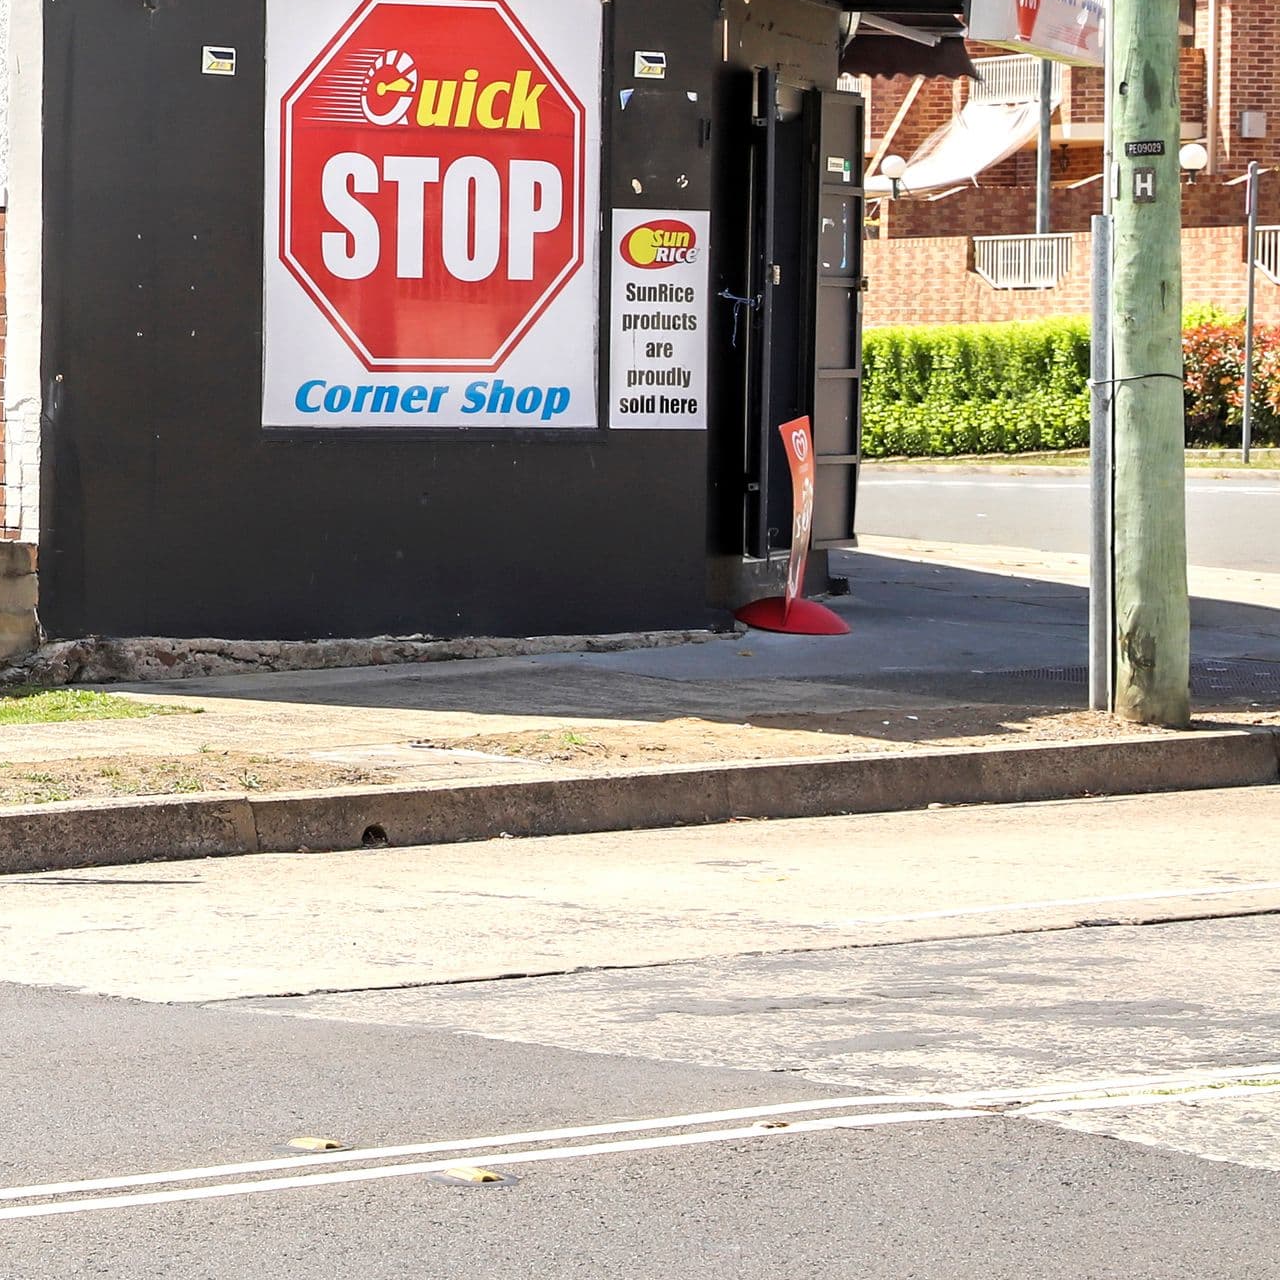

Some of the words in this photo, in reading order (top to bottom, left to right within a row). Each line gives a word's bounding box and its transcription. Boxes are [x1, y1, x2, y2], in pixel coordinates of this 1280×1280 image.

[1135, 173, 1153, 197] H
[321, 151, 564, 282] STOP
[626, 282, 694, 303] SunRice
[622, 312, 697, 332] products
[645, 341, 674, 358] are
[627, 367, 691, 388] proudly
[294, 379, 450, 415] Corner
[459, 380, 571, 421] Shop
[619, 395, 655, 414] sold
[659, 394, 698, 414] here
